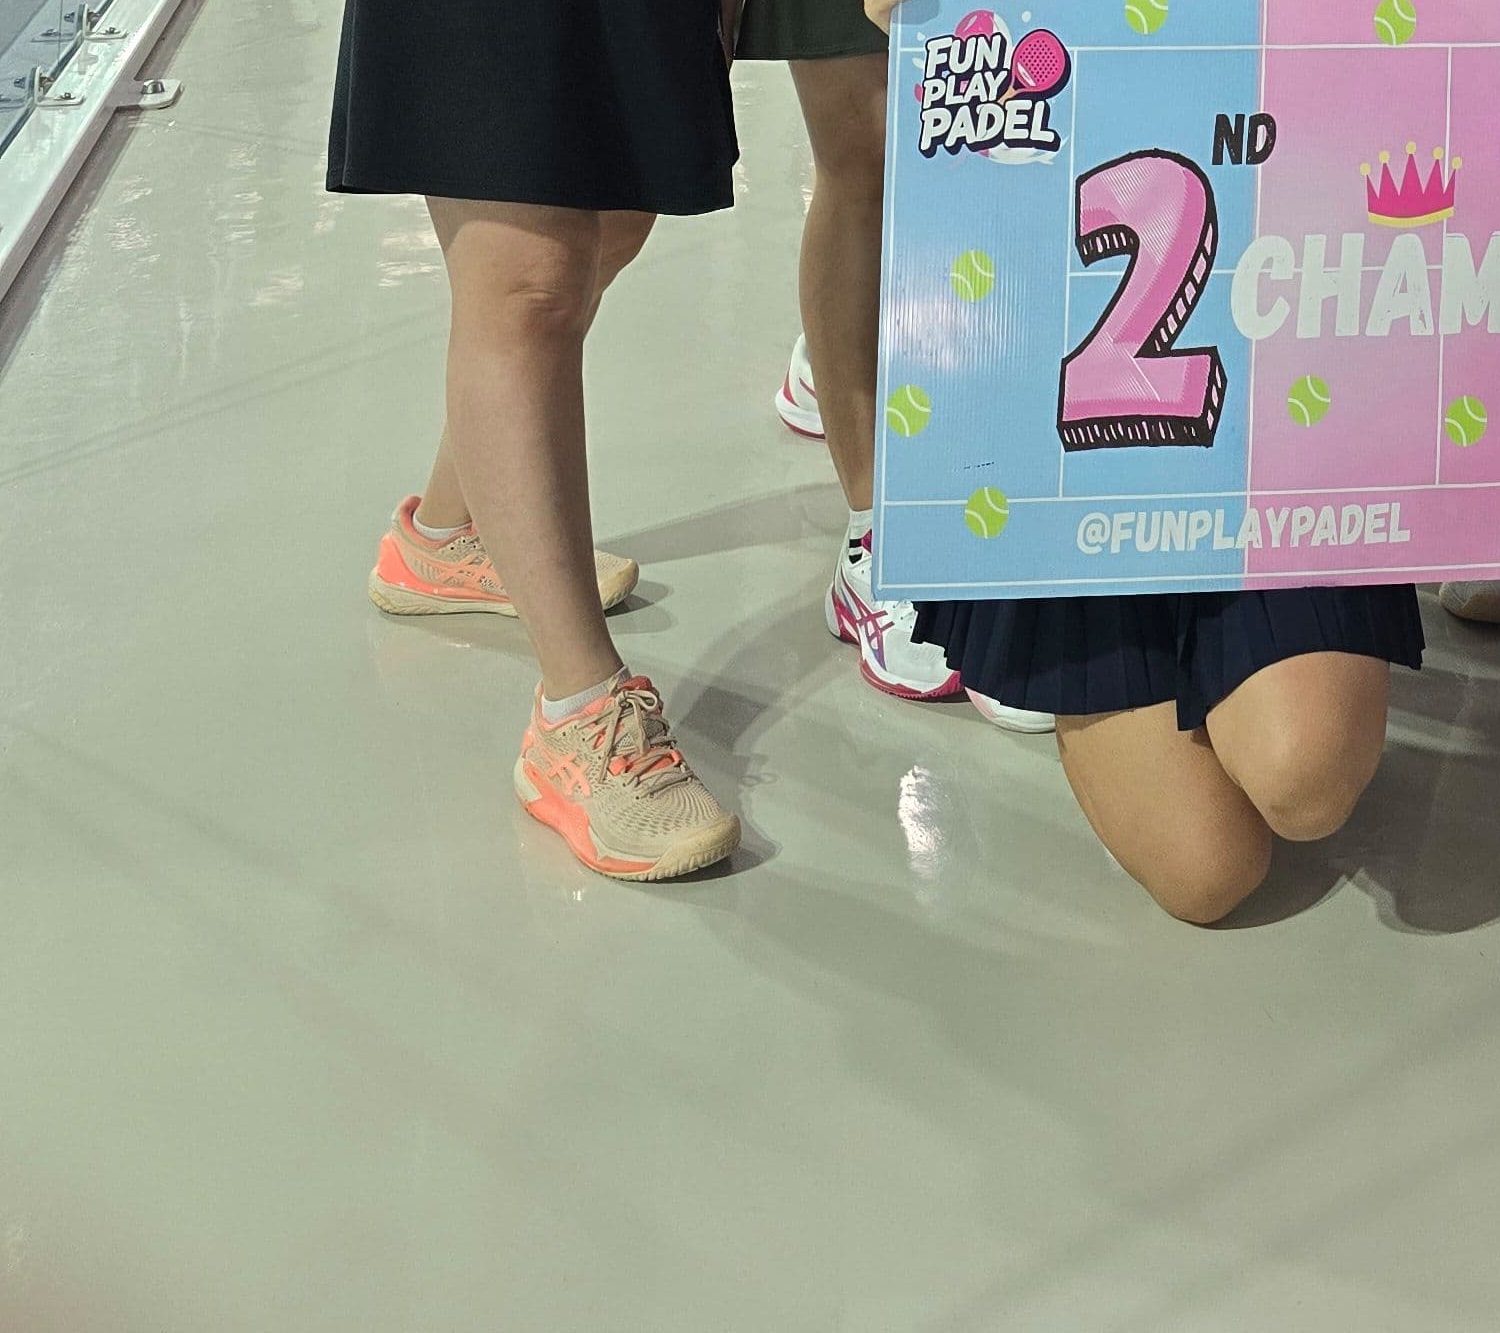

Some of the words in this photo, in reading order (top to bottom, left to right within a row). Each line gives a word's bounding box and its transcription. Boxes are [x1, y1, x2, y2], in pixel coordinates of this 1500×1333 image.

[925, 34, 1003, 79] FUN
[922, 70, 1008, 110] PLAY
[920, 99, 1056, 151] PADEL
[1075, 501, 1411, 555] @FUNPLAYPADEL
